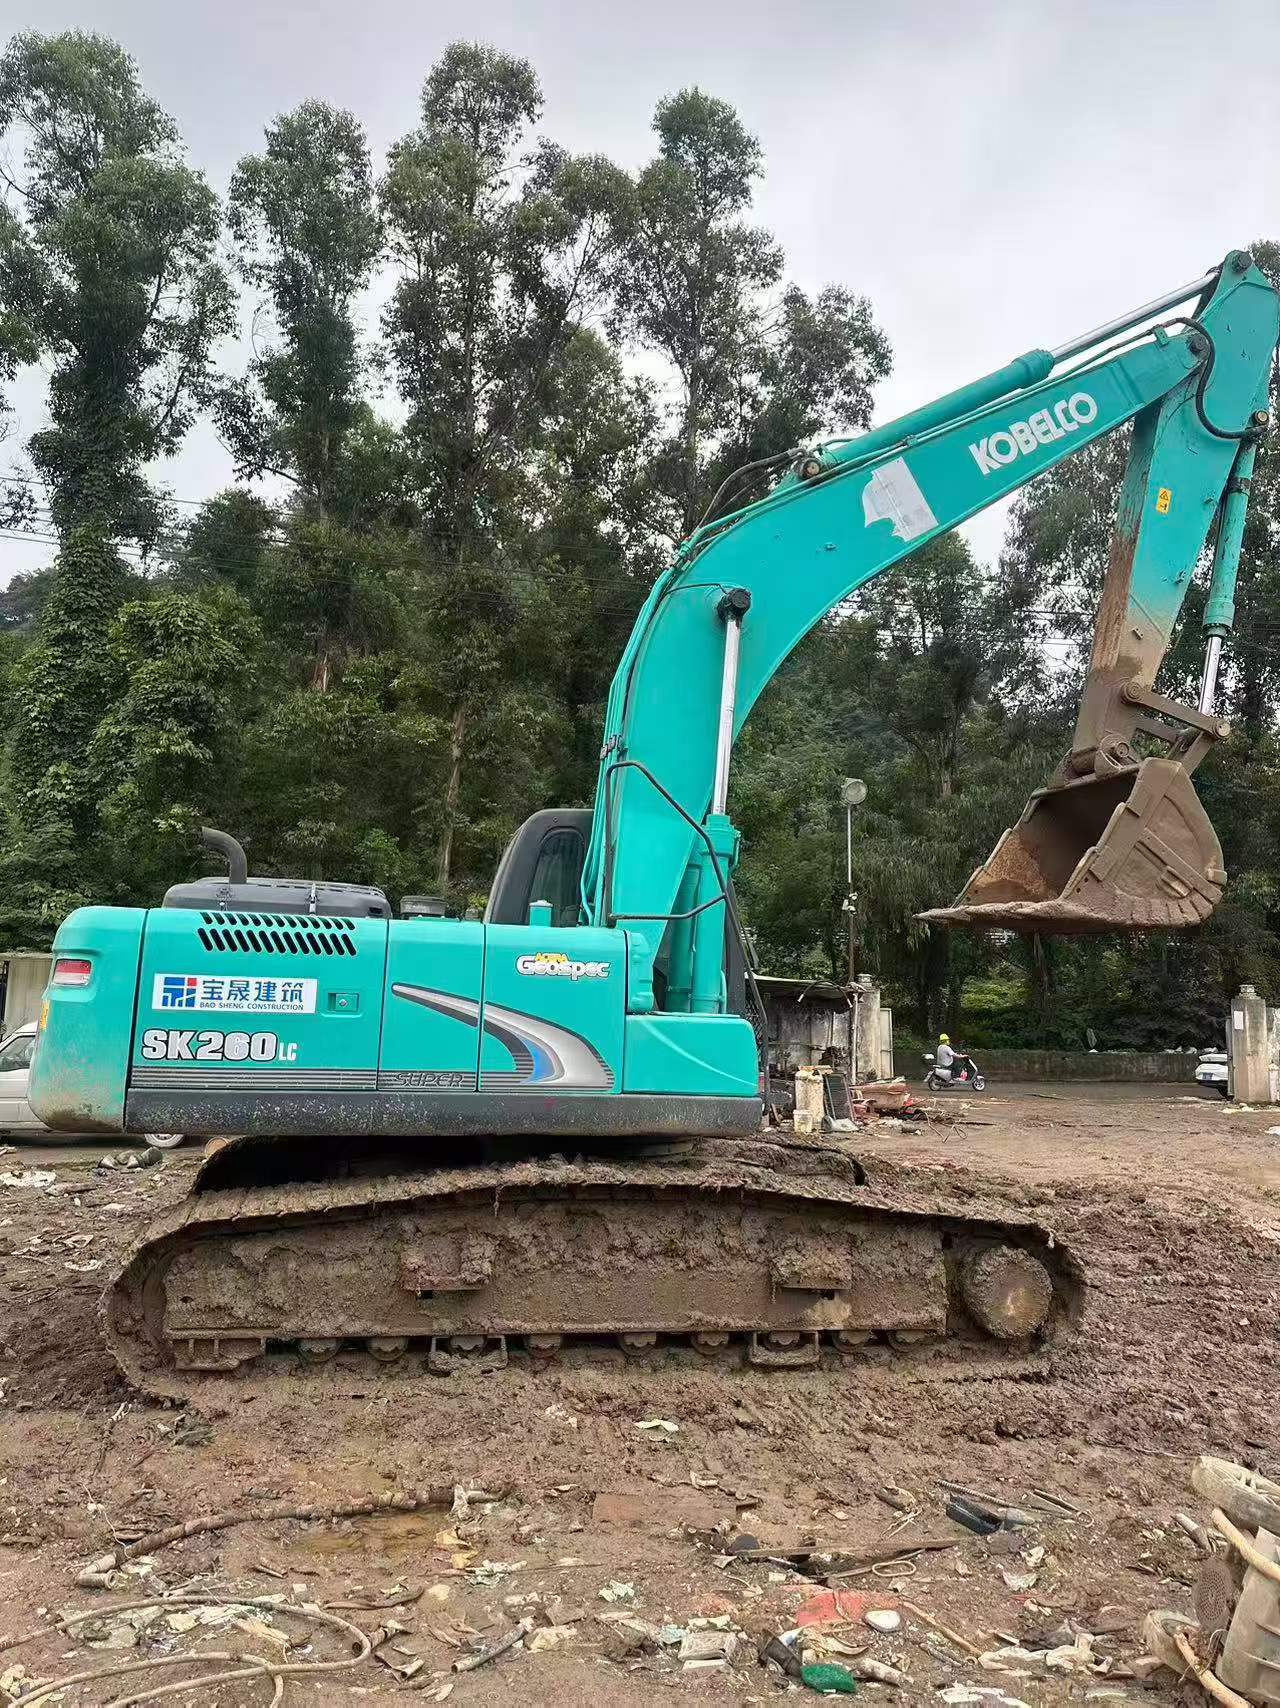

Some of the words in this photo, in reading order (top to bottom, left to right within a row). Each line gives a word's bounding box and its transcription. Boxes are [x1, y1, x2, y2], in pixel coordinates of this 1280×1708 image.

[968, 392, 1098, 476] KOBELCO
[515, 954, 611, 981] Geospec
[201, 979, 304, 1003] 宝晟建筑
[219, 1002, 244, 1010] SHENG
[247, 1003, 304, 1011] CONSTRUCTION
[395, 1072, 464, 1088] SUPER
